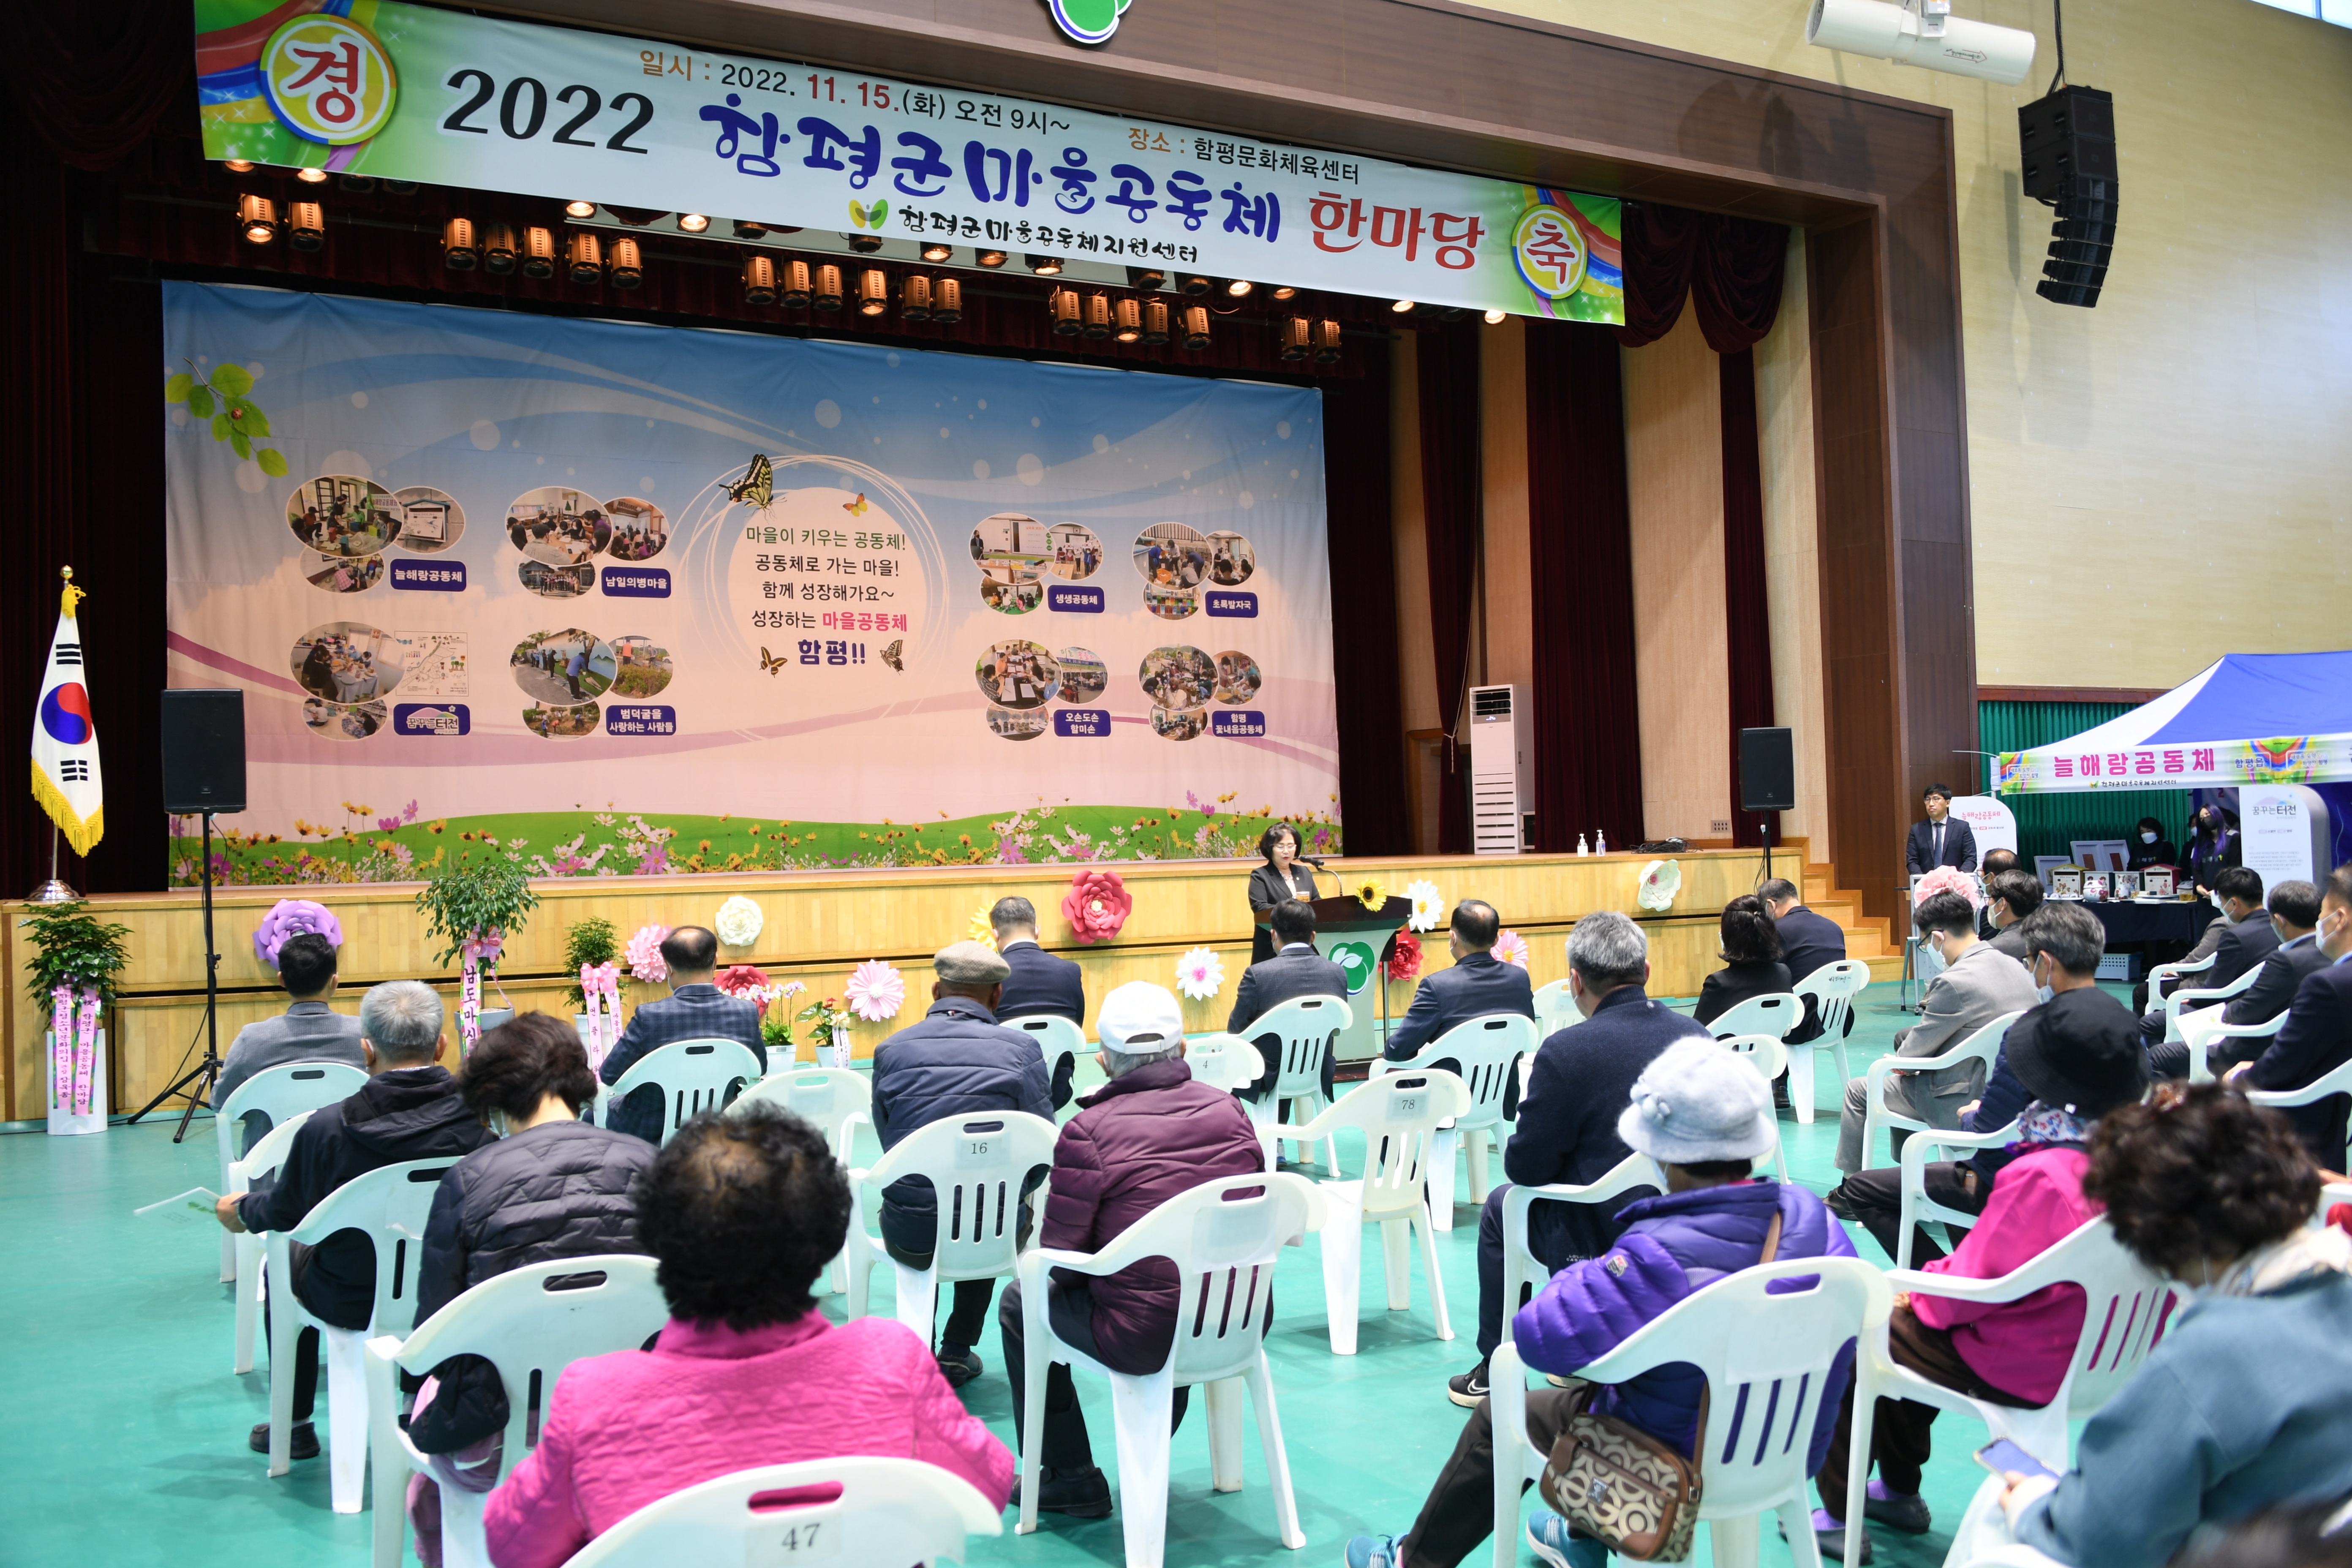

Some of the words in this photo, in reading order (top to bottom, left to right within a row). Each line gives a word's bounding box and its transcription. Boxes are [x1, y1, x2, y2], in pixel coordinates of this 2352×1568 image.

[286, 41, 358, 124] 경
[640, 50, 693, 82] 일시
[721, 62, 796, 97] 2022.
[808, 74, 845, 104] 11.
[954, 99, 1002, 128] 오전
[1010, 108, 1070, 136] 9시~
[444, 68, 656, 155] 2022
[1127, 126, 1172, 155] 장소
[1194, 136, 1359, 186] 함평문화체육센터
[1308, 191, 1485, 270] 한마당
[1526, 220, 1580, 286] 축
[746, 526, 794, 544] 마을이
[801, 529, 848, 547] 키우는
[854, 531, 906, 551] 공동체!
[755, 554, 821, 572] 공동체로
[826, 557, 857, 574] 가는
[863, 559, 899, 577] 마을!
[395, 569, 463, 583] 늘해랑공동체
[605, 576, 667, 589] 남일의병마을
[762, 581, 794, 599] 함께
[800, 583, 894, 602] 성장해가요~
[1056, 594, 1097, 605] 생생공동체
[1212, 599, 1251, 610] 초록발자국
[752, 610, 816, 629] 성장하는
[822, 612, 907, 632] 마을공동체
[798, 640, 866, 665] 함평!!
[621, 709, 662, 720] 범덕굴을
[1065, 713, 1099, 722] 오손도손
[1230, 713, 1247, 723] 함평
[407, 718, 458, 729] 꿈꾸는터전
[610, 722, 644, 733] 사랑하는
[647, 723, 673, 733] 사람들
[1070, 725, 1096, 734] 할미손
[1215, 725, 1263, 734] 꽃내음공동체
[2054, 749, 2214, 777] 늘해랑공동체
[2235, 757, 2264, 768] 함평읍
[1962, 811, 2000, 821] 늘해랑공동체
[2252, 805, 2296, 815] 꿈꾸는터전
[1203, 1060, 1208, 1069] 4
[1402, 1099, 1415, 1110] 78
[971, 1142, 987, 1154] 16
[781, 1523, 820, 1550] 47
